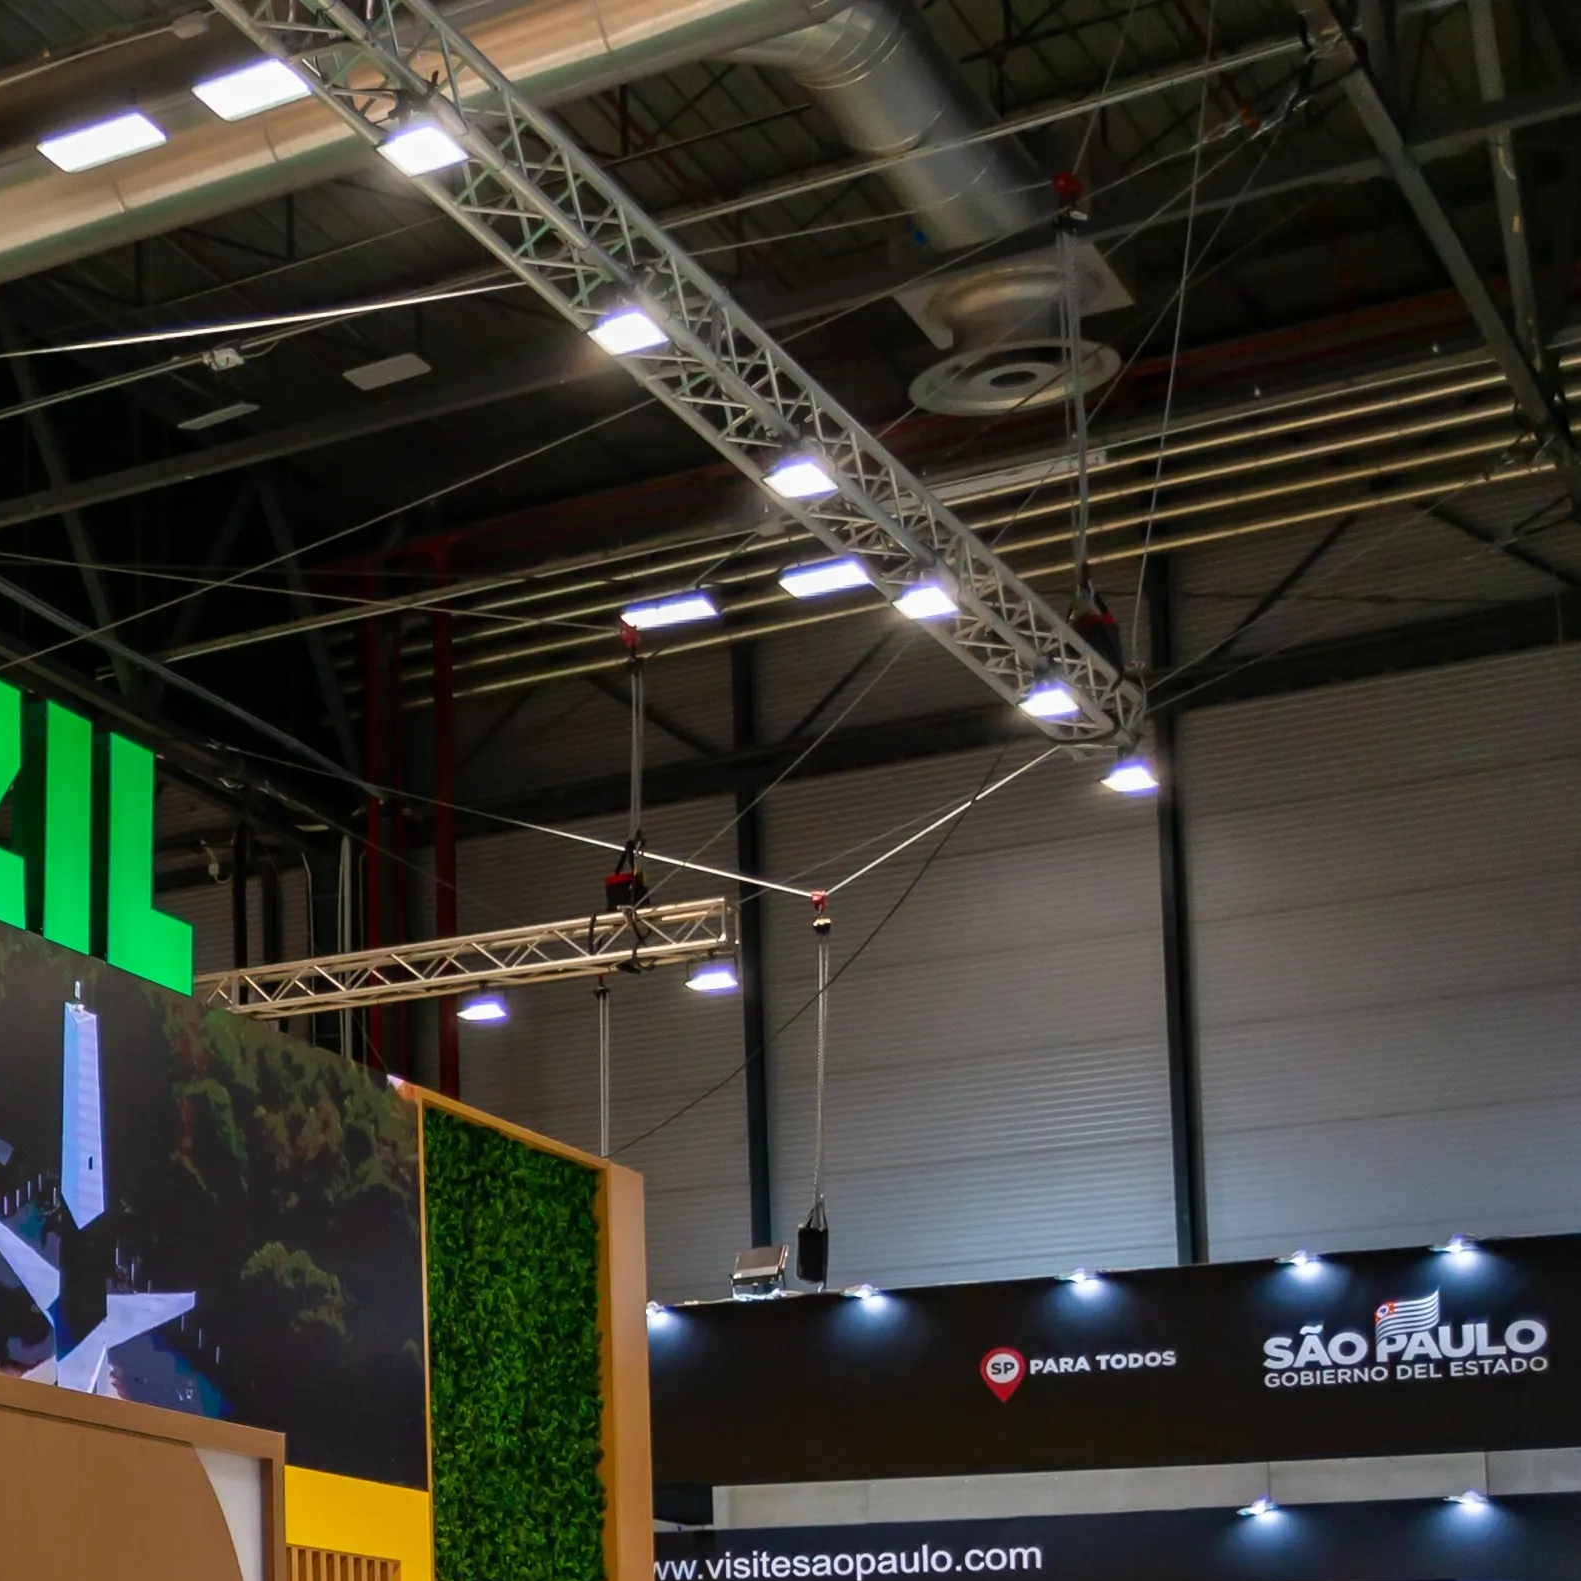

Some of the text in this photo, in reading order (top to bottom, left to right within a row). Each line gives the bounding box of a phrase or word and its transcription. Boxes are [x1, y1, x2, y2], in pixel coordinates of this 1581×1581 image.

[1263, 1319, 1549, 1370] SÃO PAULO
[991, 1361, 1016, 1376] SP
[1029, 1350, 1177, 1375] PARA TODOS
[1263, 1355, 1549, 1389] GOBIERNO DEL ESTADO
